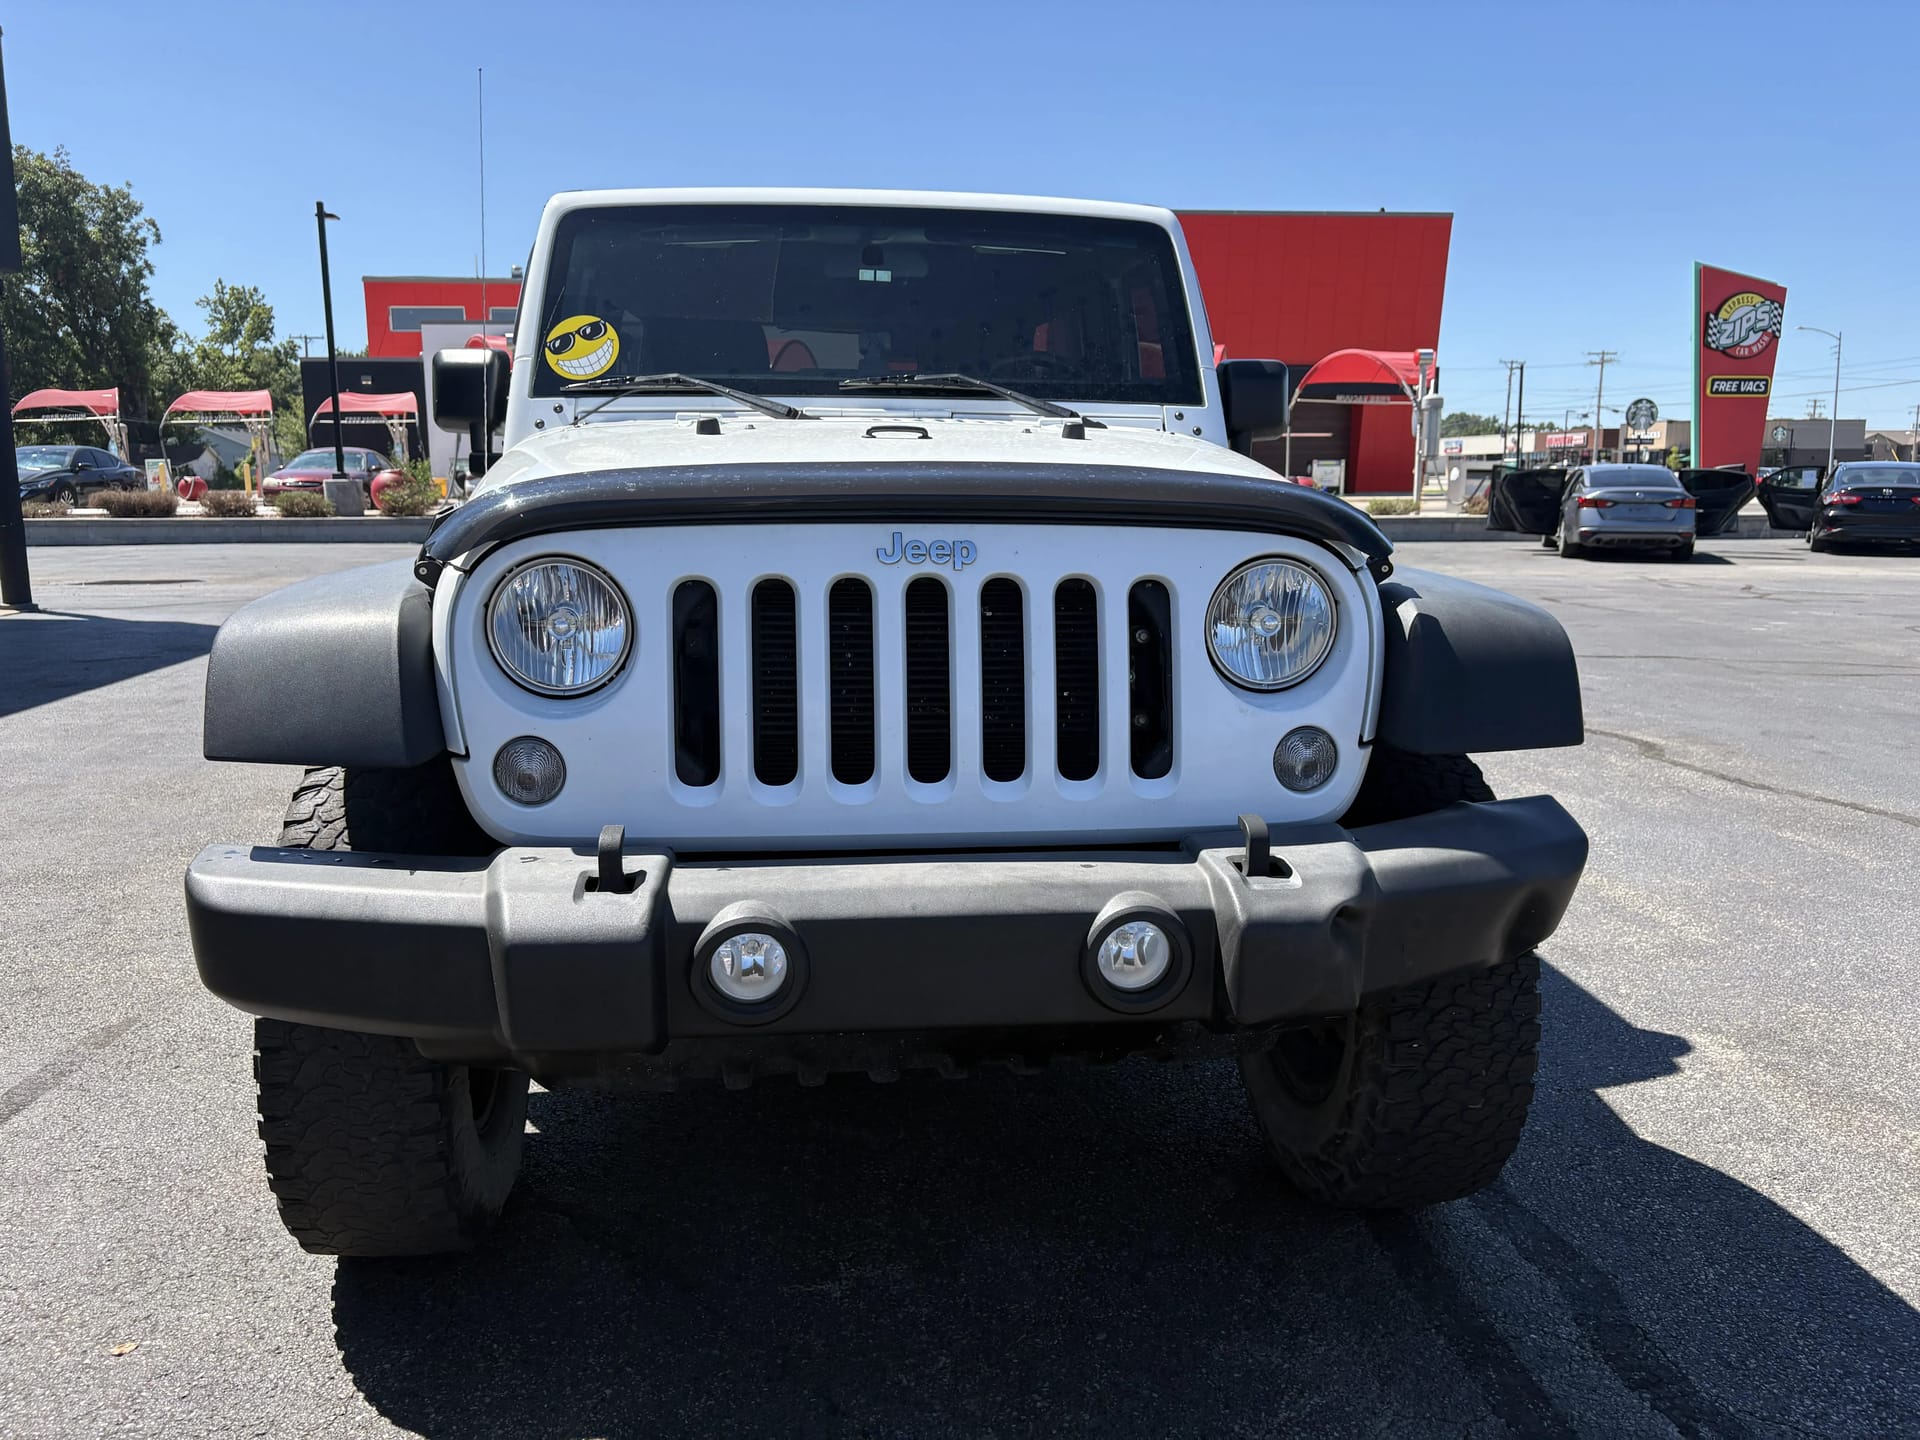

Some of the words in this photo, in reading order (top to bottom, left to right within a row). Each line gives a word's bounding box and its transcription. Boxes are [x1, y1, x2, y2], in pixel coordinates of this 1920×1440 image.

[1724, 296, 1755, 314] EXPRESS
[1719, 304, 1772, 345] ZIPS
[1735, 347, 1749, 355] CAR
[1751, 334, 1770, 353] WASH
[1712, 381, 1739, 392] FREE
[1740, 381, 1766, 392] VACS
[876, 531, 978, 572] Jeep
